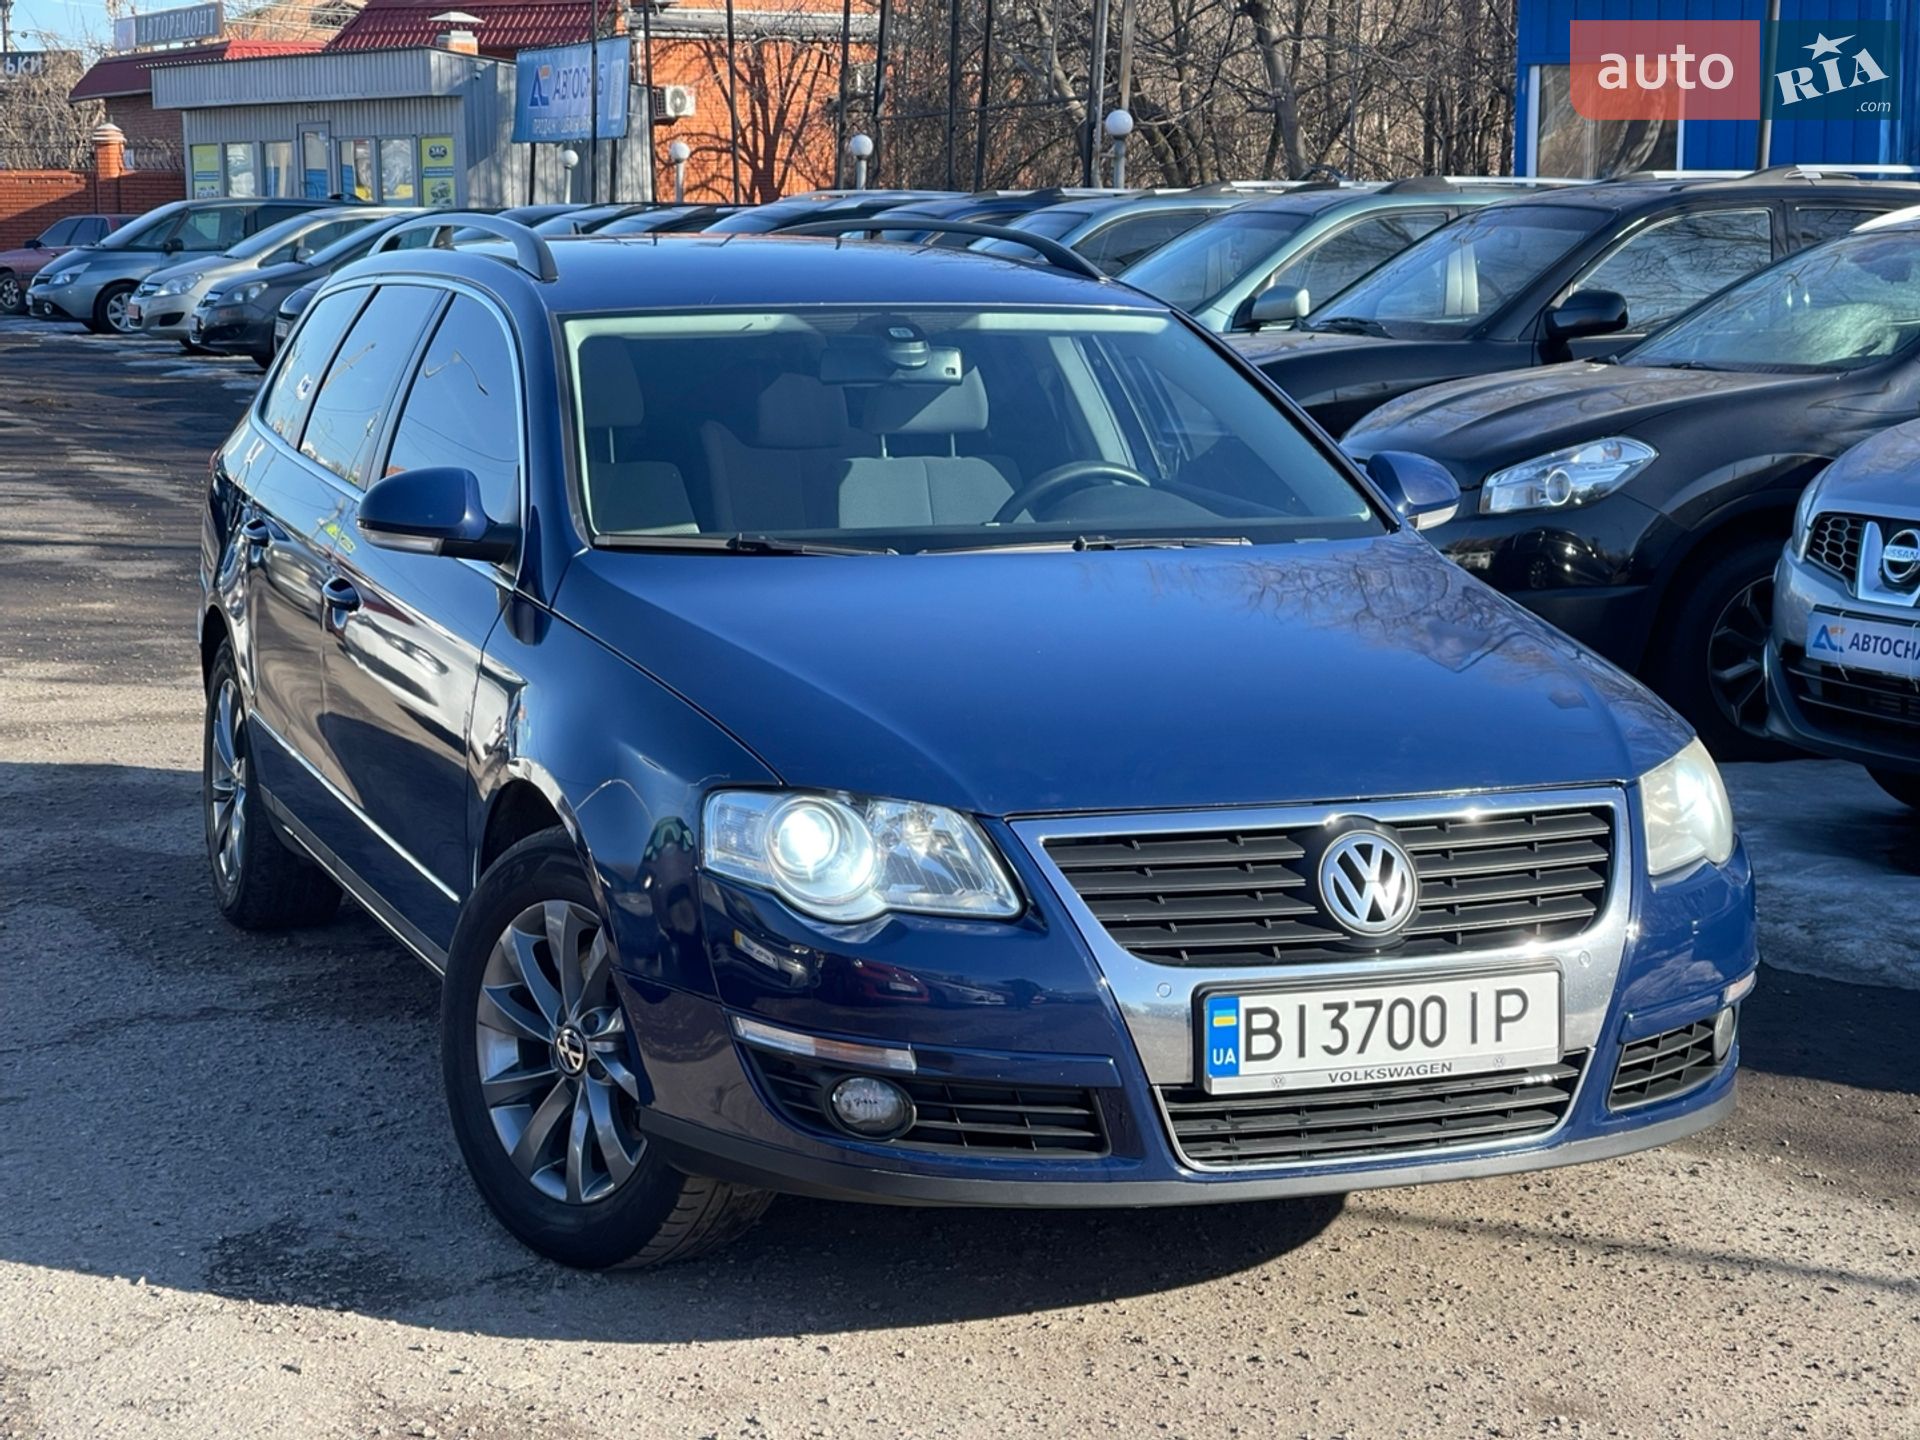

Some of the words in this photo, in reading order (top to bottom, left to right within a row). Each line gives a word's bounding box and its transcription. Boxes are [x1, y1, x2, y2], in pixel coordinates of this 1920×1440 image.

[140, 8, 216, 43] АВТОРЕМОНТ
[552, 63, 605, 101] АВТОСНБ
[1887, 547, 1920, 561] SSAN
[1212, 1047, 1237, 1066] UA
[1328, 1061, 1453, 1084] VOLKSWAGEN
